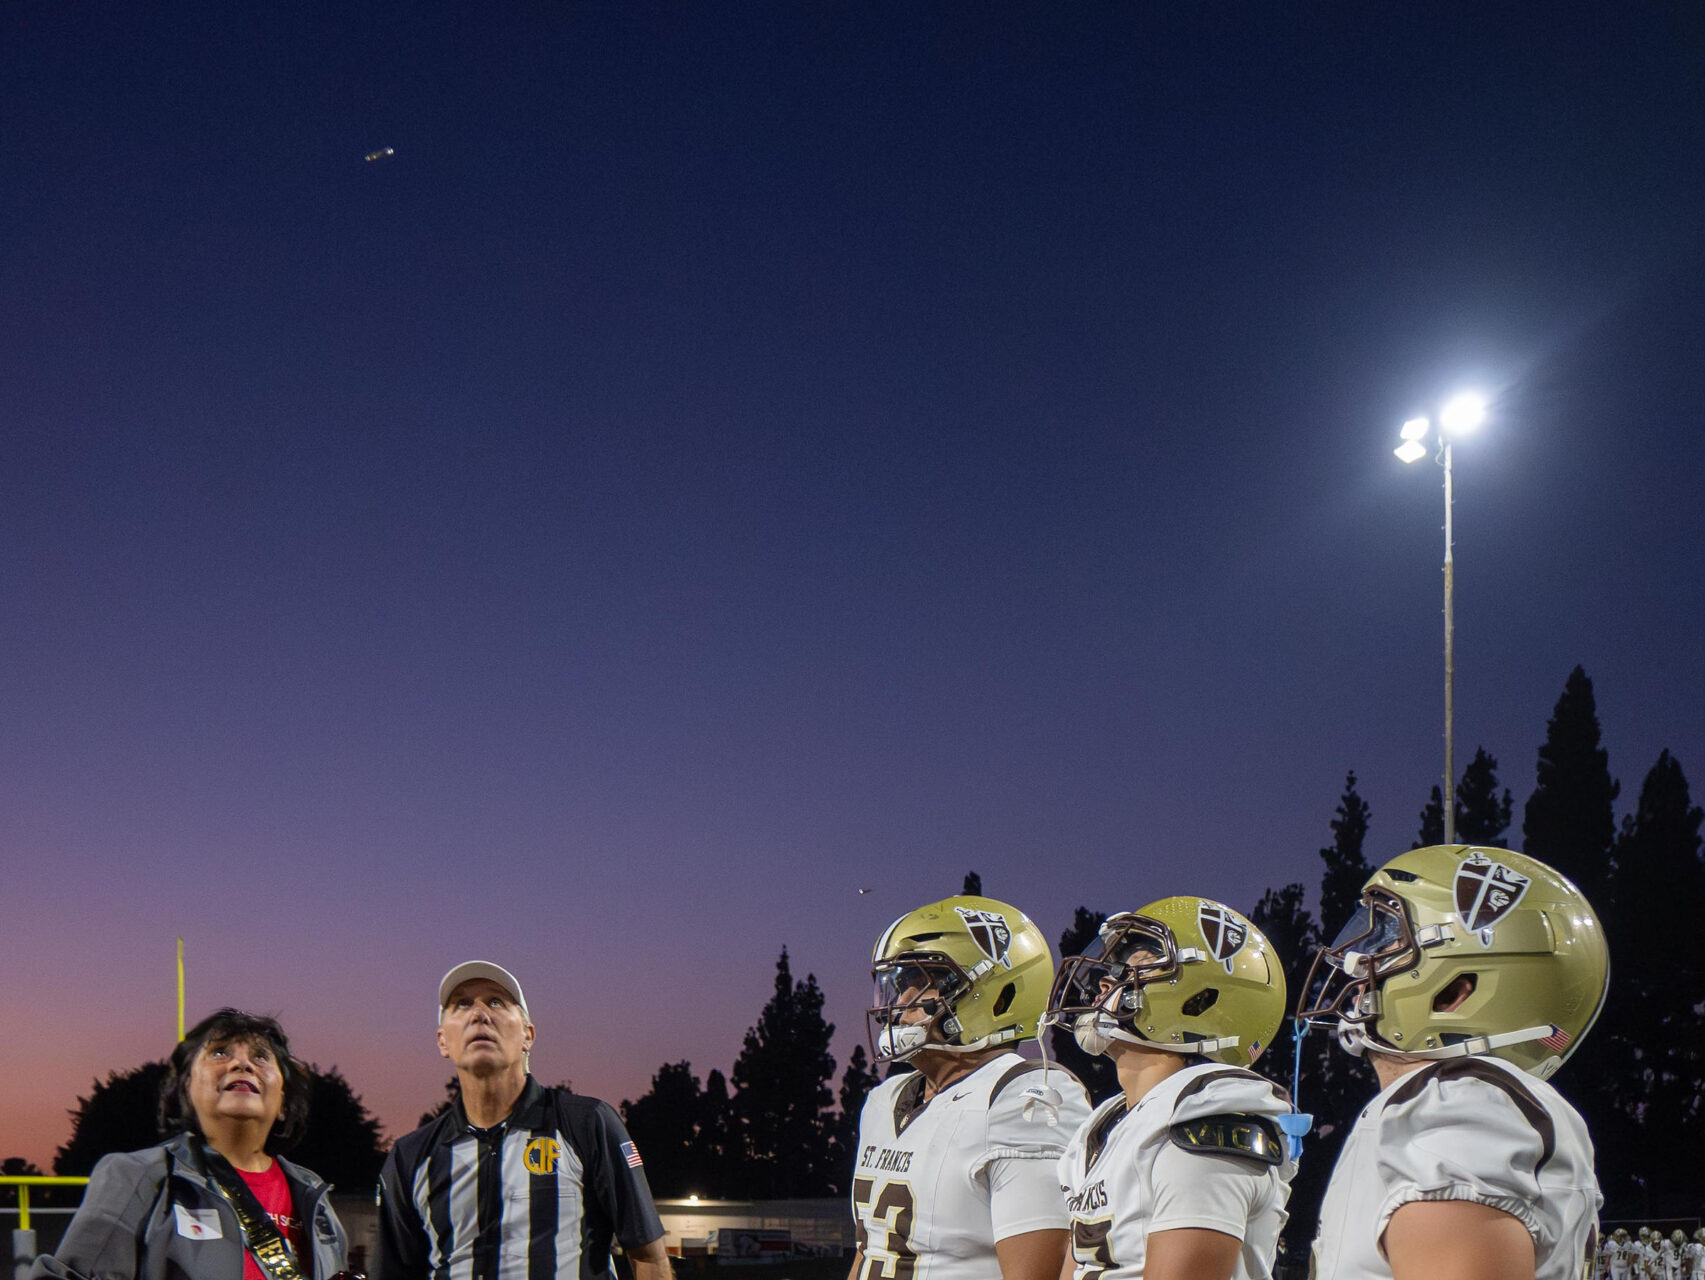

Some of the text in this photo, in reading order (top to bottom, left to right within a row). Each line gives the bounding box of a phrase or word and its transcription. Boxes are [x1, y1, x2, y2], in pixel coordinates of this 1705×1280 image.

[523, 1136, 561, 1175] CIF
[861, 1145, 914, 1173] ST. FRANCIS
